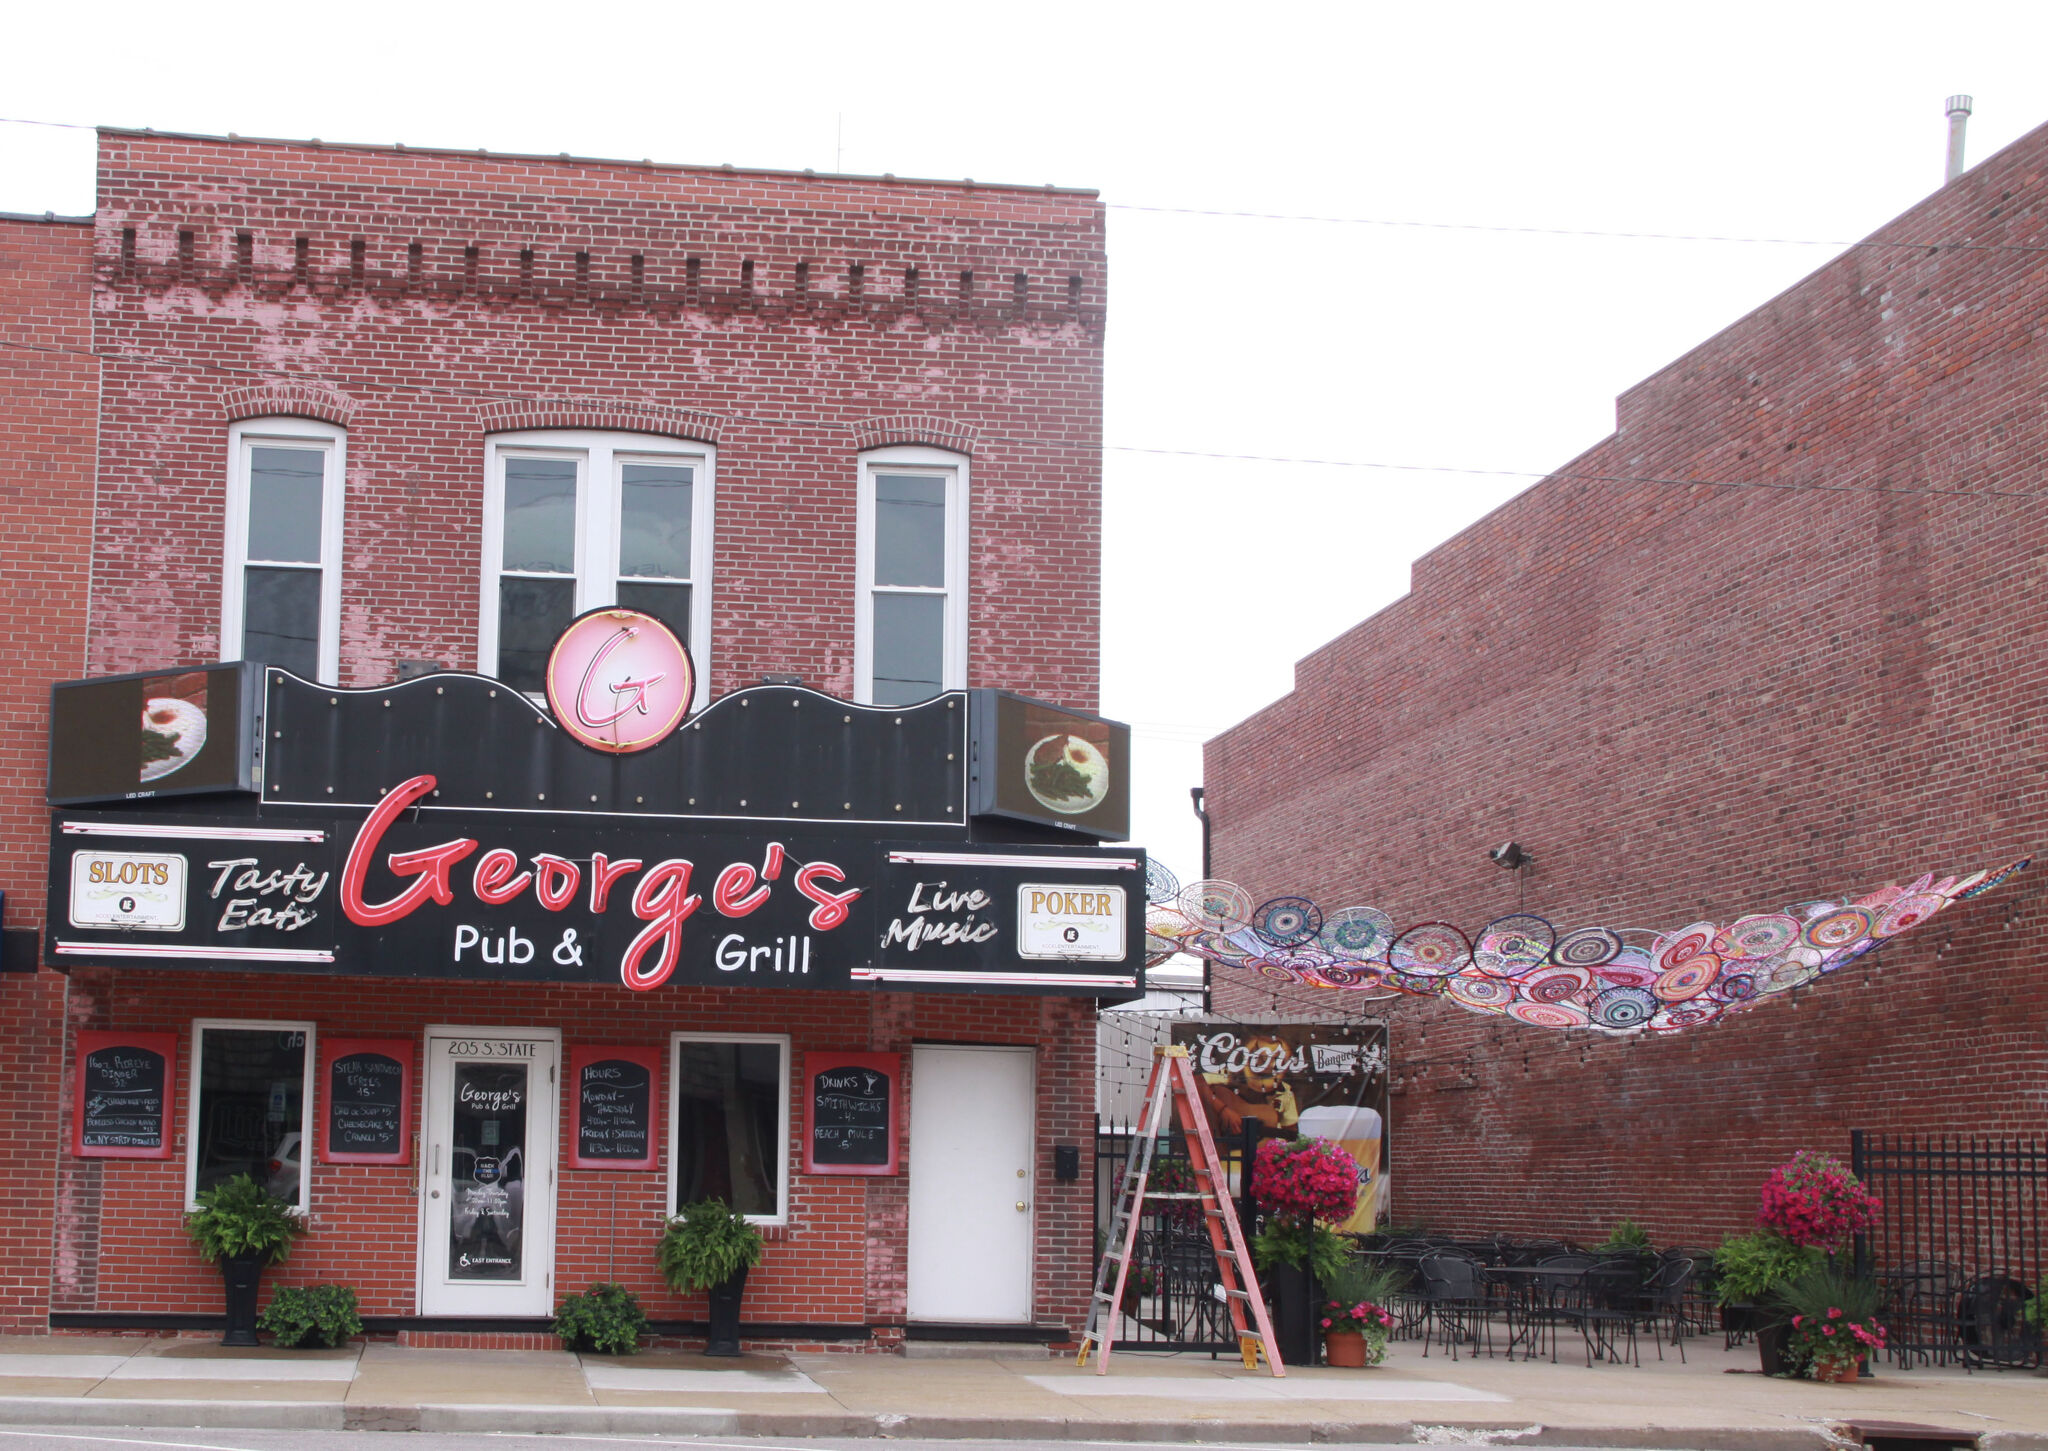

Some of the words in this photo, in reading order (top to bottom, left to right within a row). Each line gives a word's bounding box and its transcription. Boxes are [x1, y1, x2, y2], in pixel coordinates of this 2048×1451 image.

[576, 626, 667, 728] G
[89, 861, 169, 885] SLOTS
[208, 858, 329, 902] Tasty
[341, 774, 864, 991] George's
[908, 881, 990, 912] Live
[1030, 891, 1112, 916] POKER
[218, 899, 317, 931] Eats
[881, 915, 998, 951] Music
[454, 925, 534, 965] Pub
[552, 928, 583, 966] &
[715, 934, 810, 973] Grill
[448, 1041, 478, 1055] 205
[497, 1043, 537, 1057] STATE
[1197, 1032, 1309, 1074] Coors
[585, 1067, 621, 1080] HOURS
[820, 1076, 858, 1089] DRINKS
[460, 1082, 521, 1111] George's
[816, 1096, 881, 1112] SMITHWICKS
[581, 1126, 609, 1139] FRIDAY
[814, 1128, 840, 1139] PEACH
[848, 1128, 874, 1140] MULE
